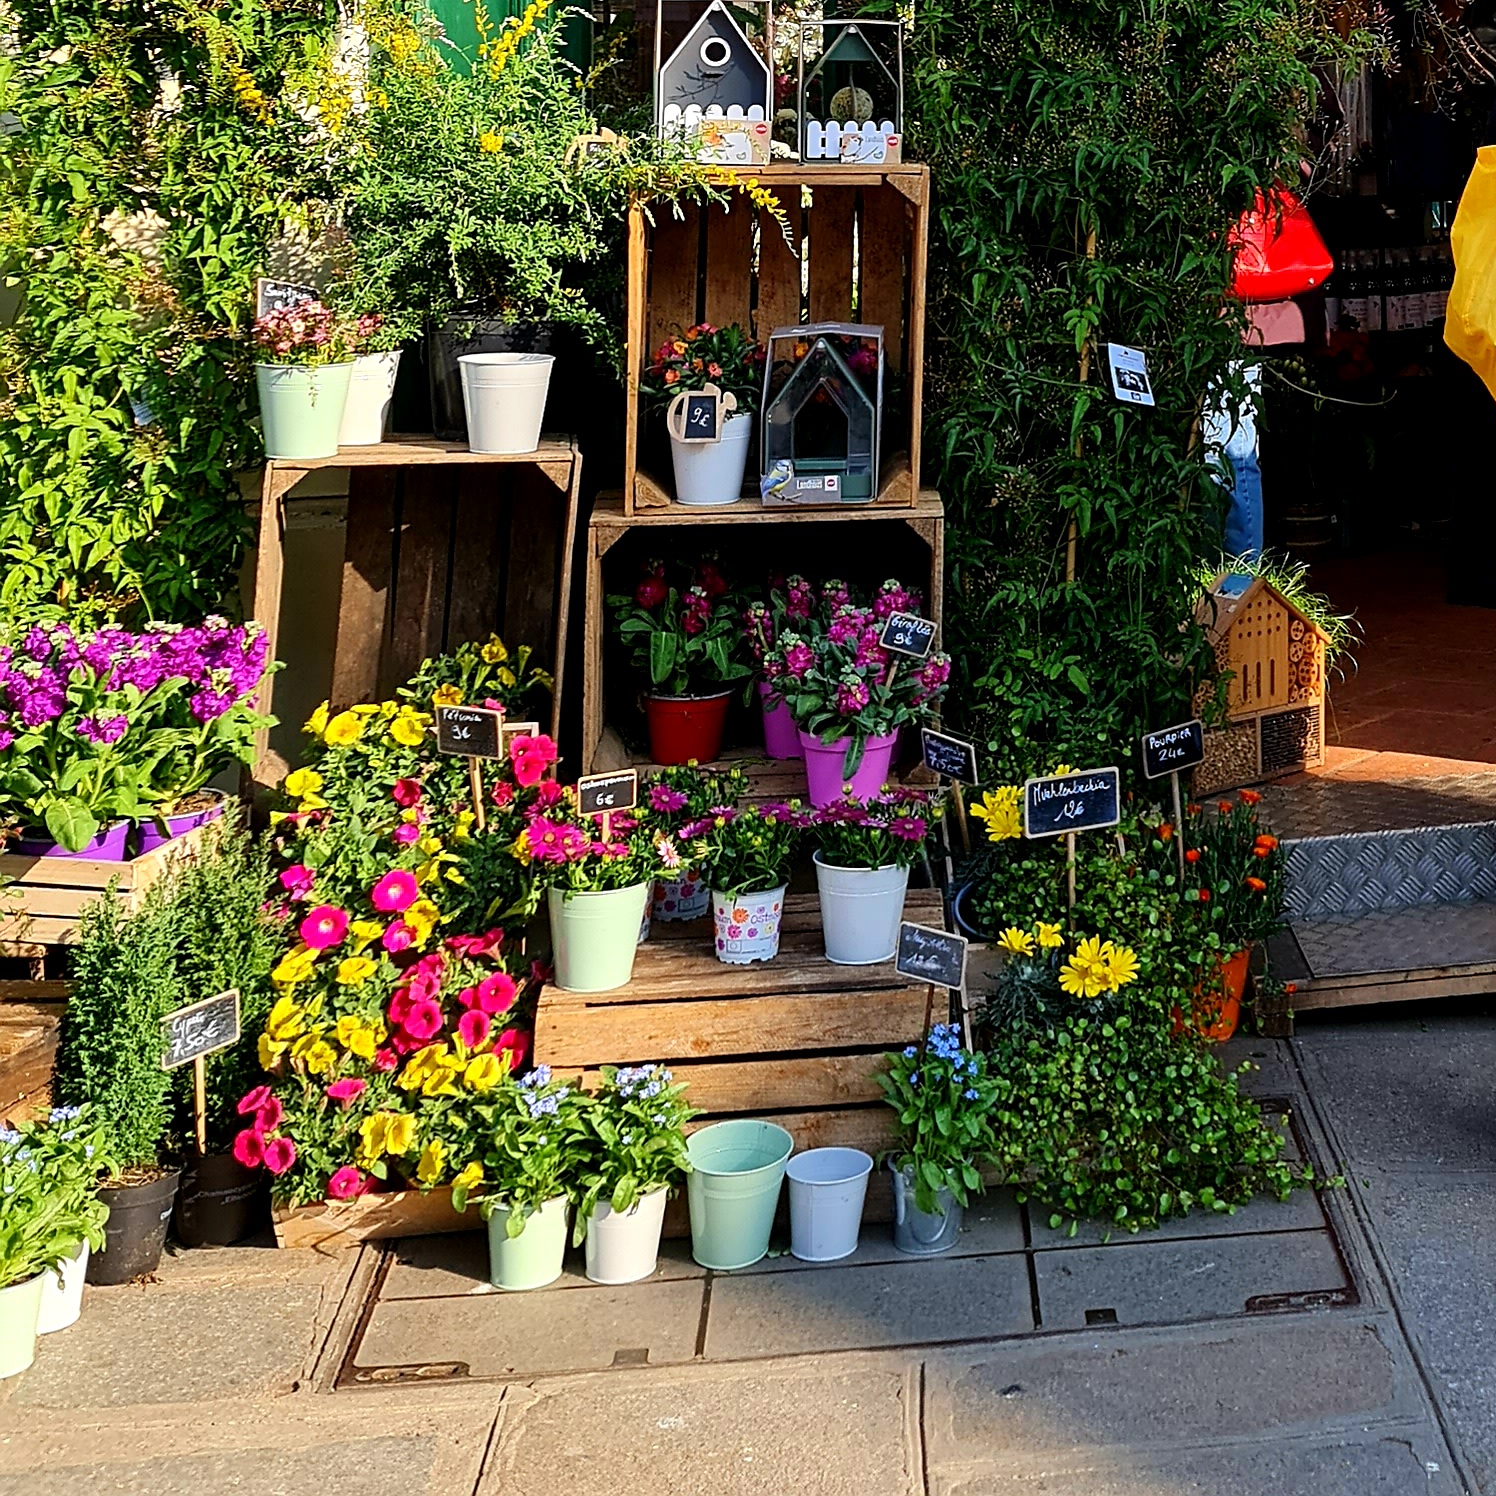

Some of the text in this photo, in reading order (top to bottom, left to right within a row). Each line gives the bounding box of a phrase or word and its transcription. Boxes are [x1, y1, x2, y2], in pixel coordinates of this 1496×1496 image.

[893, 632, 913, 646] 9€
[452, 724, 472, 740] 9€
[1158, 748, 1186, 761] 24€
[595, 792, 615, 806] 6€
